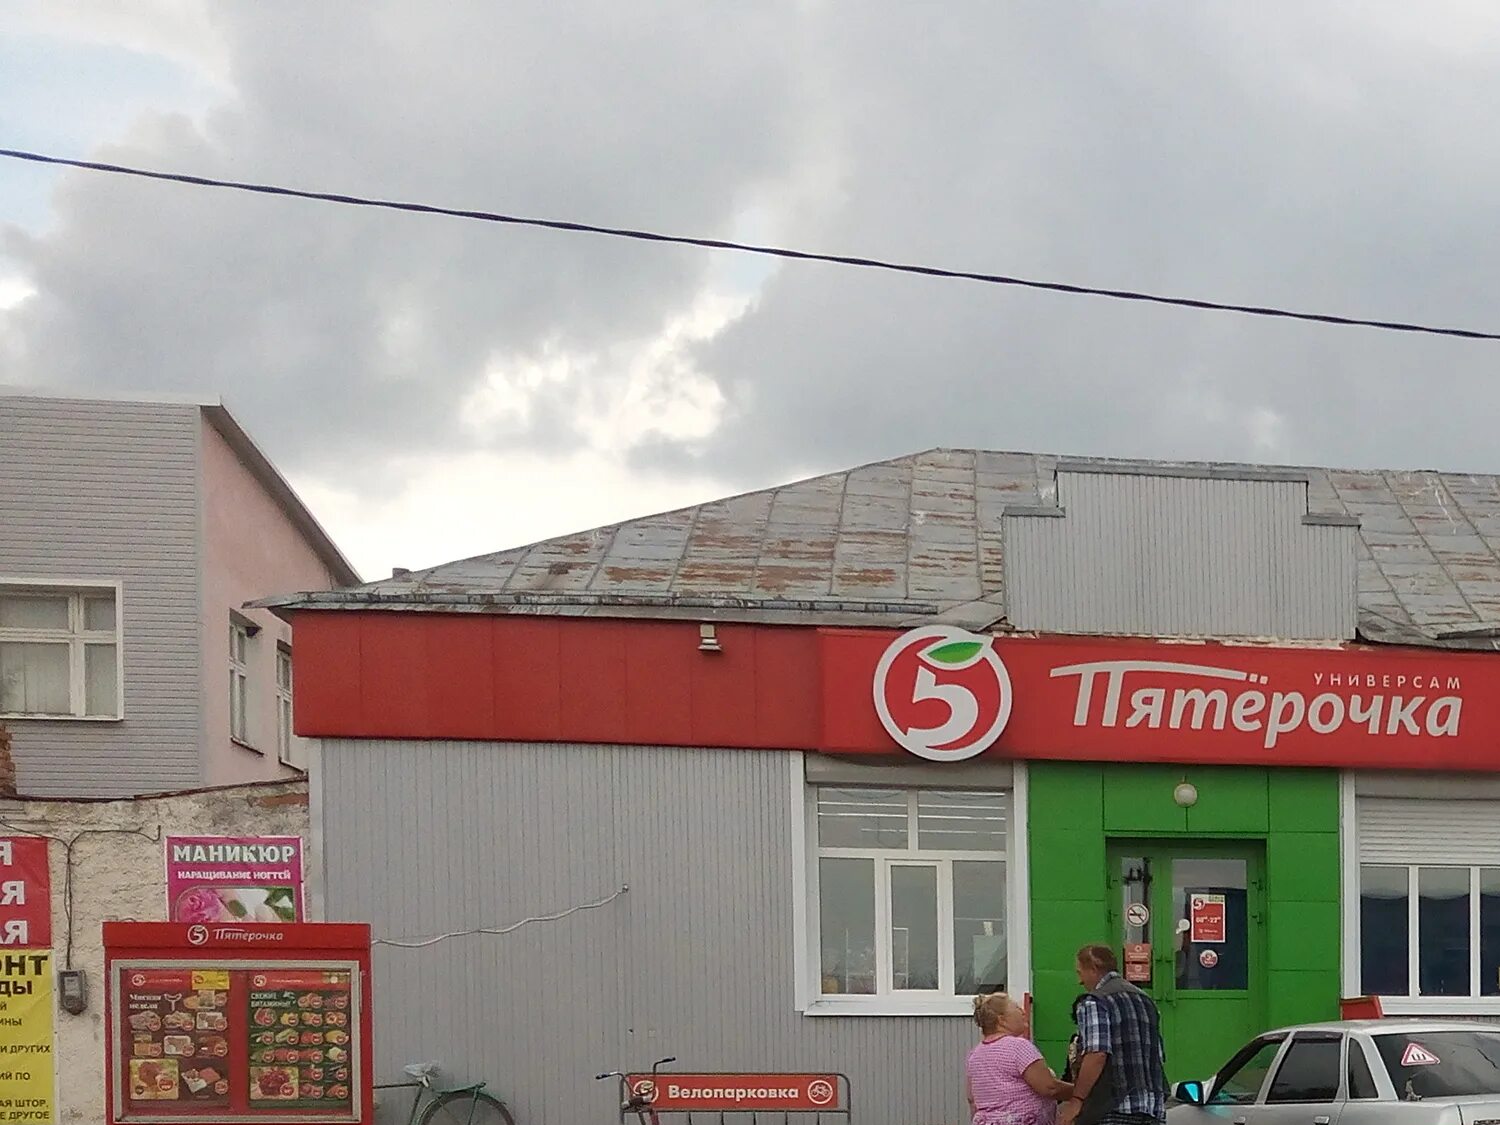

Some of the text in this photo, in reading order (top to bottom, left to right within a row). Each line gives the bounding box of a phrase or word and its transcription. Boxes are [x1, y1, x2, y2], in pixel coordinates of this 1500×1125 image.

[1313, 672, 1461, 690] УНИВЕРСАМ
[1050, 659, 1463, 749] Пятёрочка
[172, 844, 296, 864] МАНИКЮР
[177, 869, 292, 881] НАРАЩИВАНИЕ НОГТЕЙ
[0, 920, 28, 945] Я
[0, 954, 48, 976] НТ
[10, 1044, 51, 1054] ДРУГИХ
[1411, 1053, 1427, 1062] Ш
[15, 1071, 31, 1081] ПО
[668, 1084, 799, 1102] Велопарковка
[15, 1099, 49, 1108] ШТОР,
[9, 1111, 50, 1120] ДРУГОЕ
